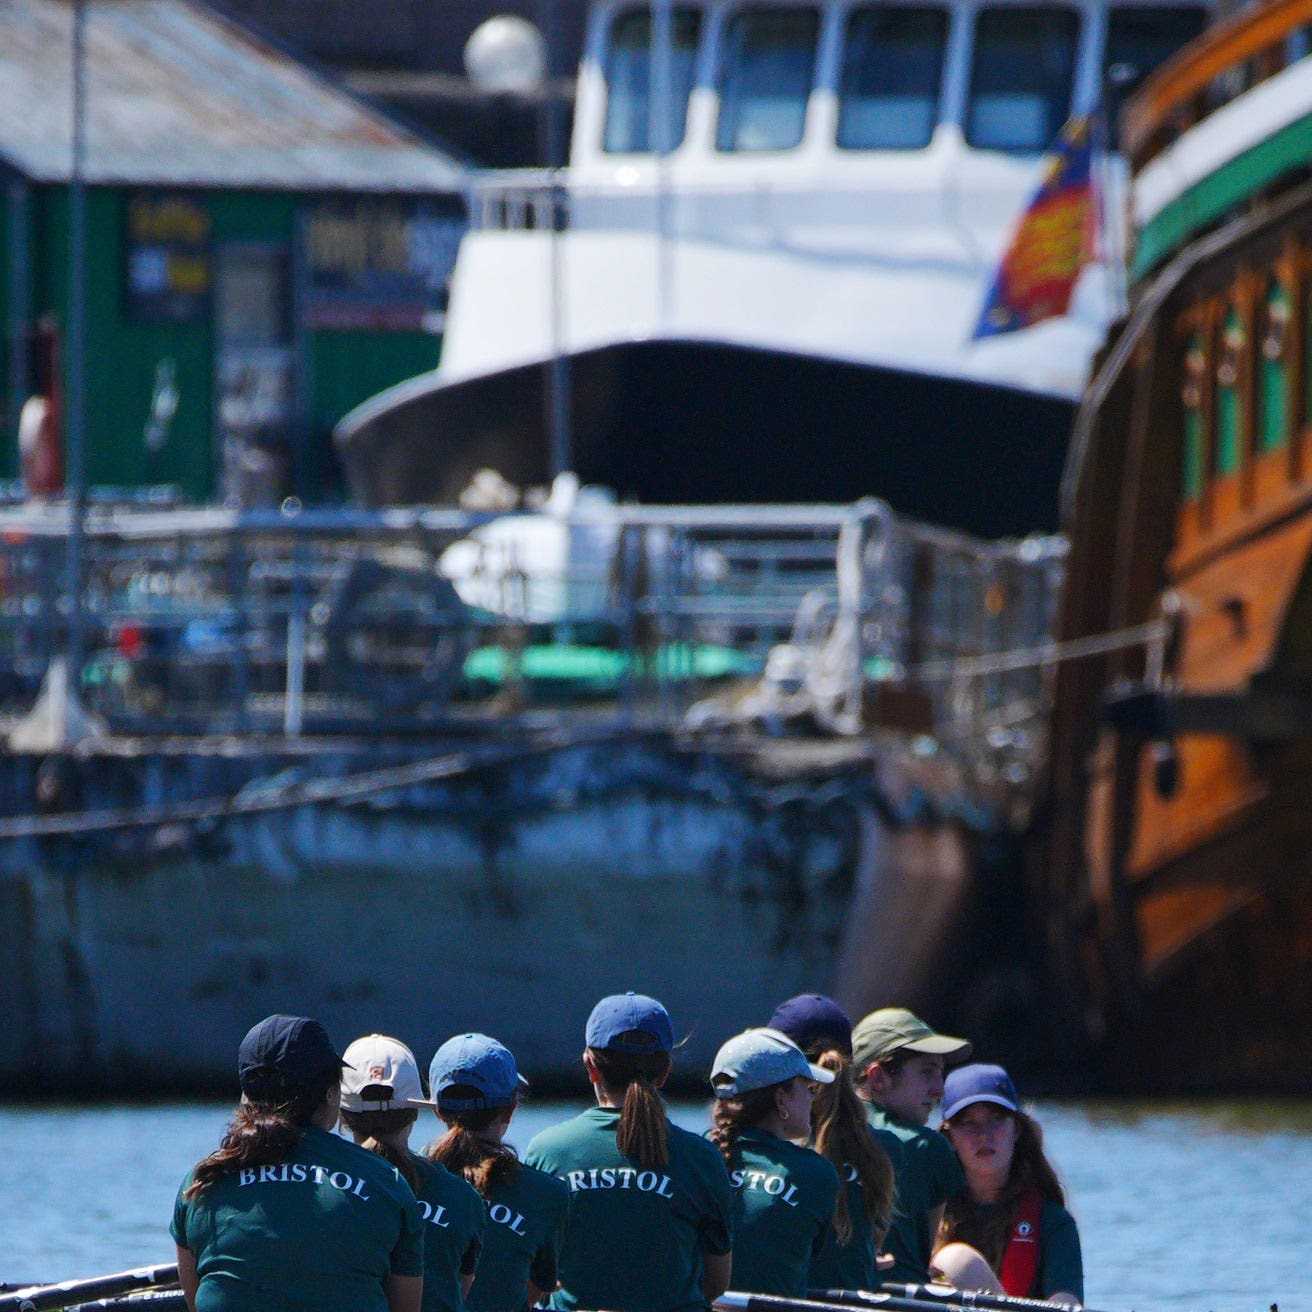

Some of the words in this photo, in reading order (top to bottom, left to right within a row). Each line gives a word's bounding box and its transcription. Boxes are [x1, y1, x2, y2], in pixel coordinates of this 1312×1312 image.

[239, 1163, 370, 1201] BRISTOL
[561, 1167, 674, 1199] RISTOL
[488, 1201, 527, 1238] OL
